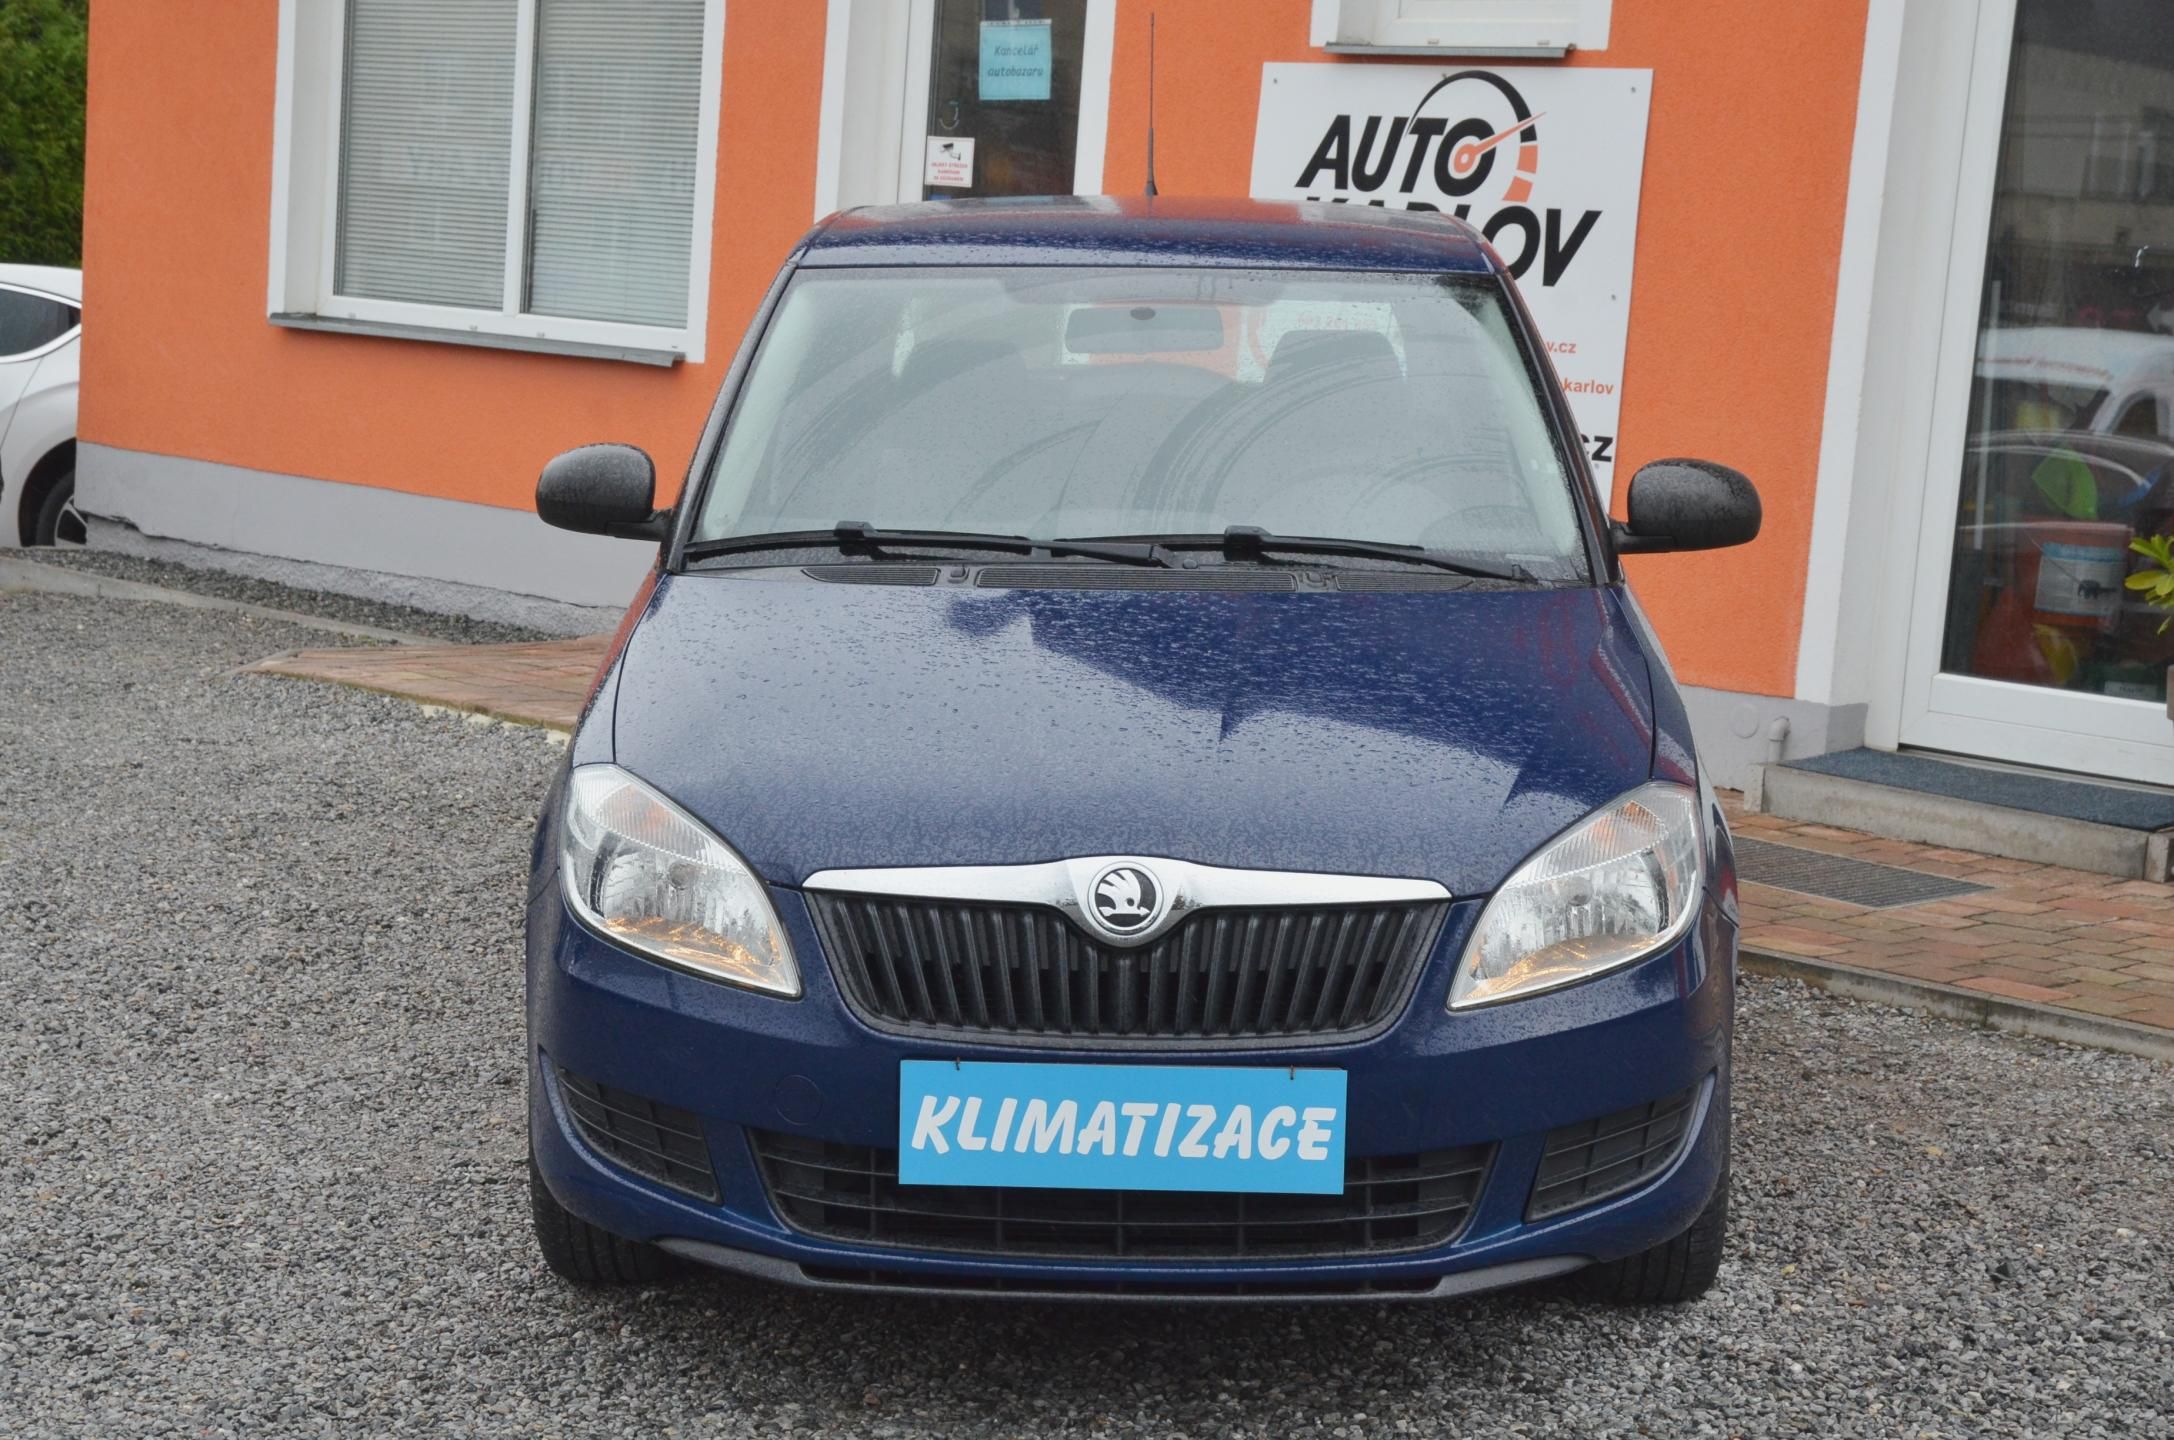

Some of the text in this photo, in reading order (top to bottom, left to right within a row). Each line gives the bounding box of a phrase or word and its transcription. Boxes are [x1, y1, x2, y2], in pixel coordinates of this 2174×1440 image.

[987, 65, 1043, 77] autobazaru
[1294, 114, 1497, 197] AUTO
[1560, 377, 1614, 394] karlov
[911, 1095, 1337, 1161] KLIMATIZACE
